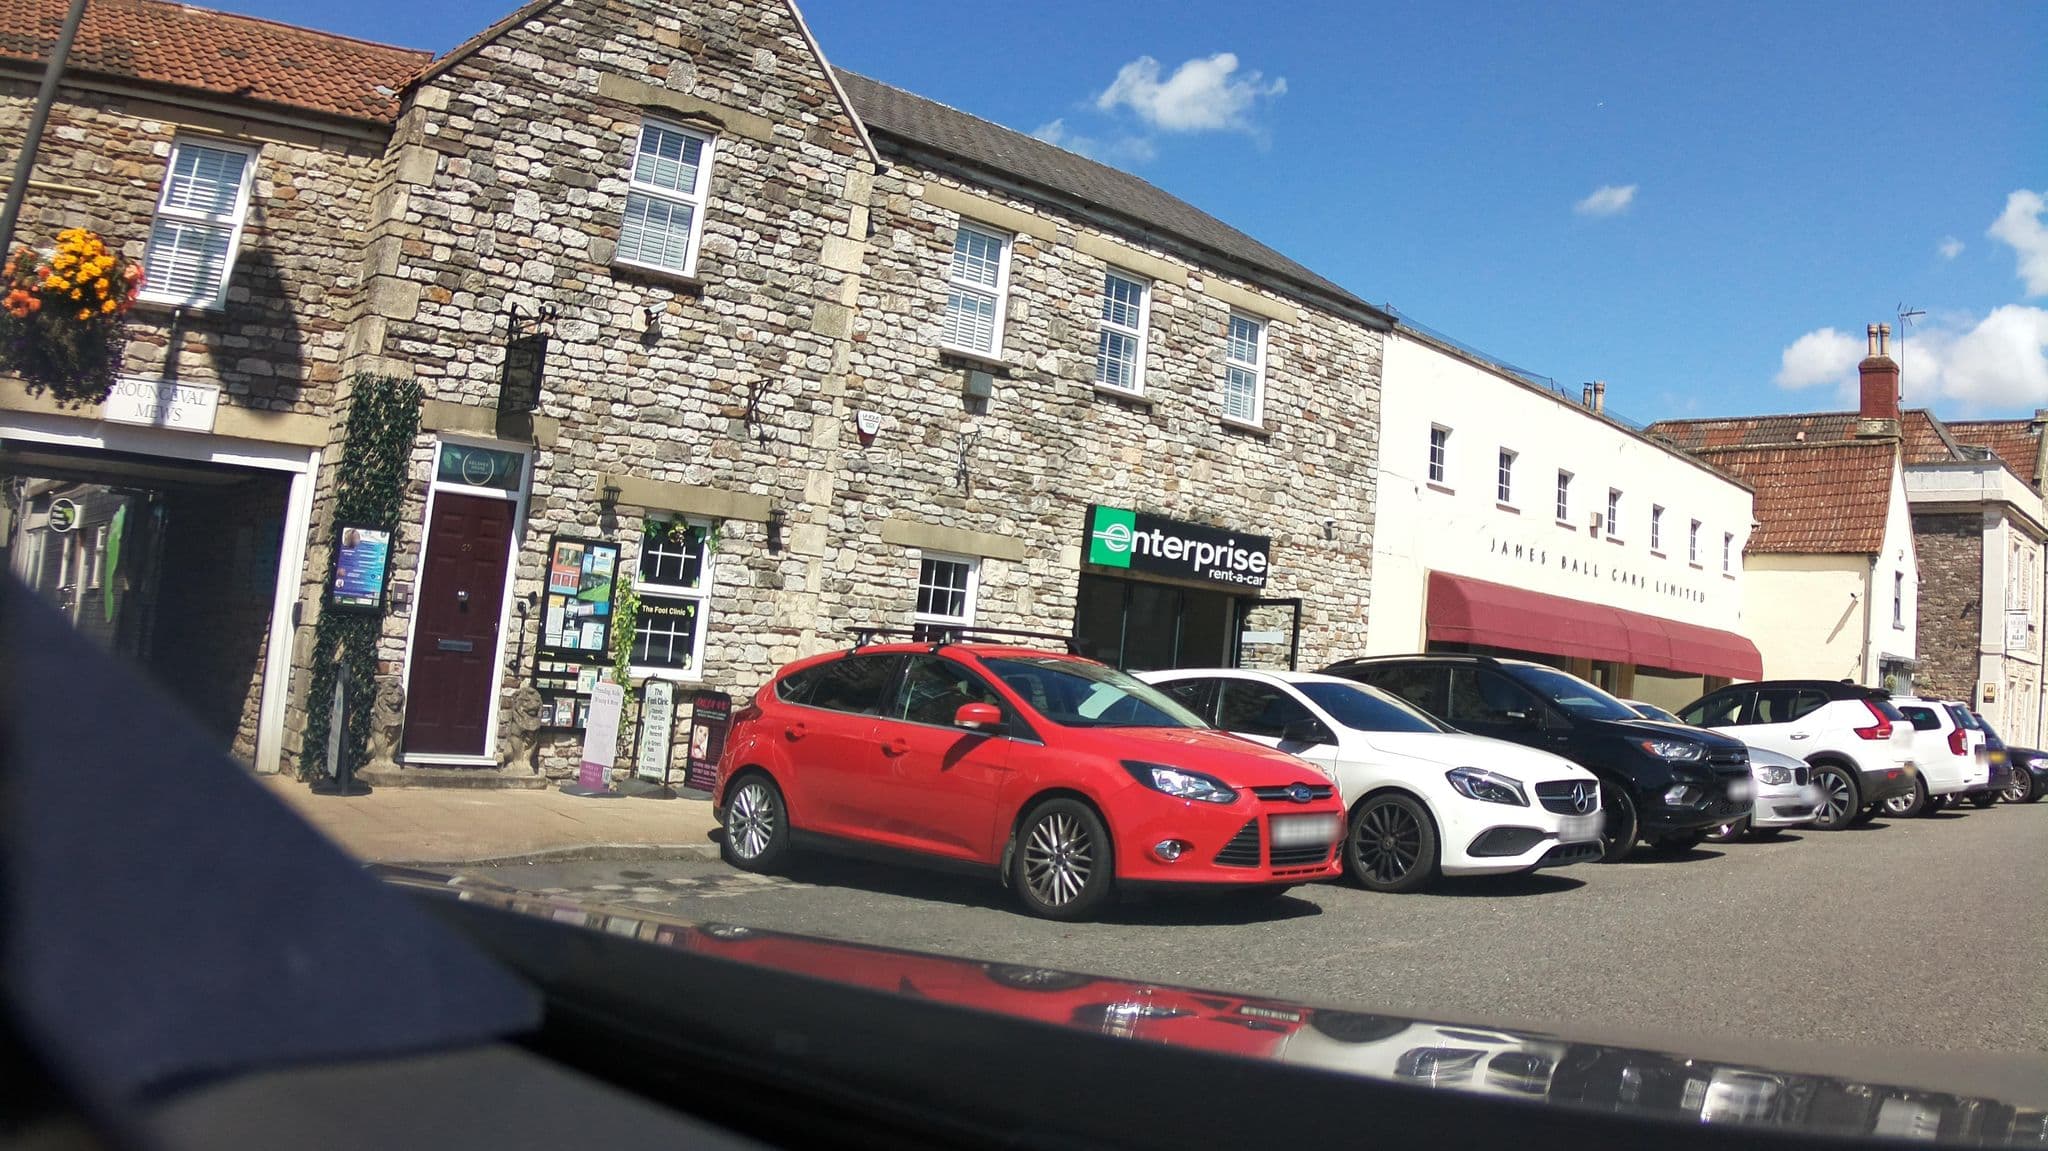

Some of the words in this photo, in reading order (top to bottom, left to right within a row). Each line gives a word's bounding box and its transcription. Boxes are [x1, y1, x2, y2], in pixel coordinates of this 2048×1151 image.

[116, 381, 206, 406] ROUNCEVAL
[135, 404, 183, 422] MEWS
[1093, 523, 1267, 573] enterprise
[1209, 569, 1265, 586] rent-a-car
[1491, 538, 1546, 565] JAMES
[1561, 556, 1599, 578] BALL
[1611, 568, 1645, 589] CARS
[1655, 580, 1705, 603] LIMITED
[642, 604, 654, 613] The
[654, 606, 668, 615] Foot
[669, 608, 686, 616] Clinic
